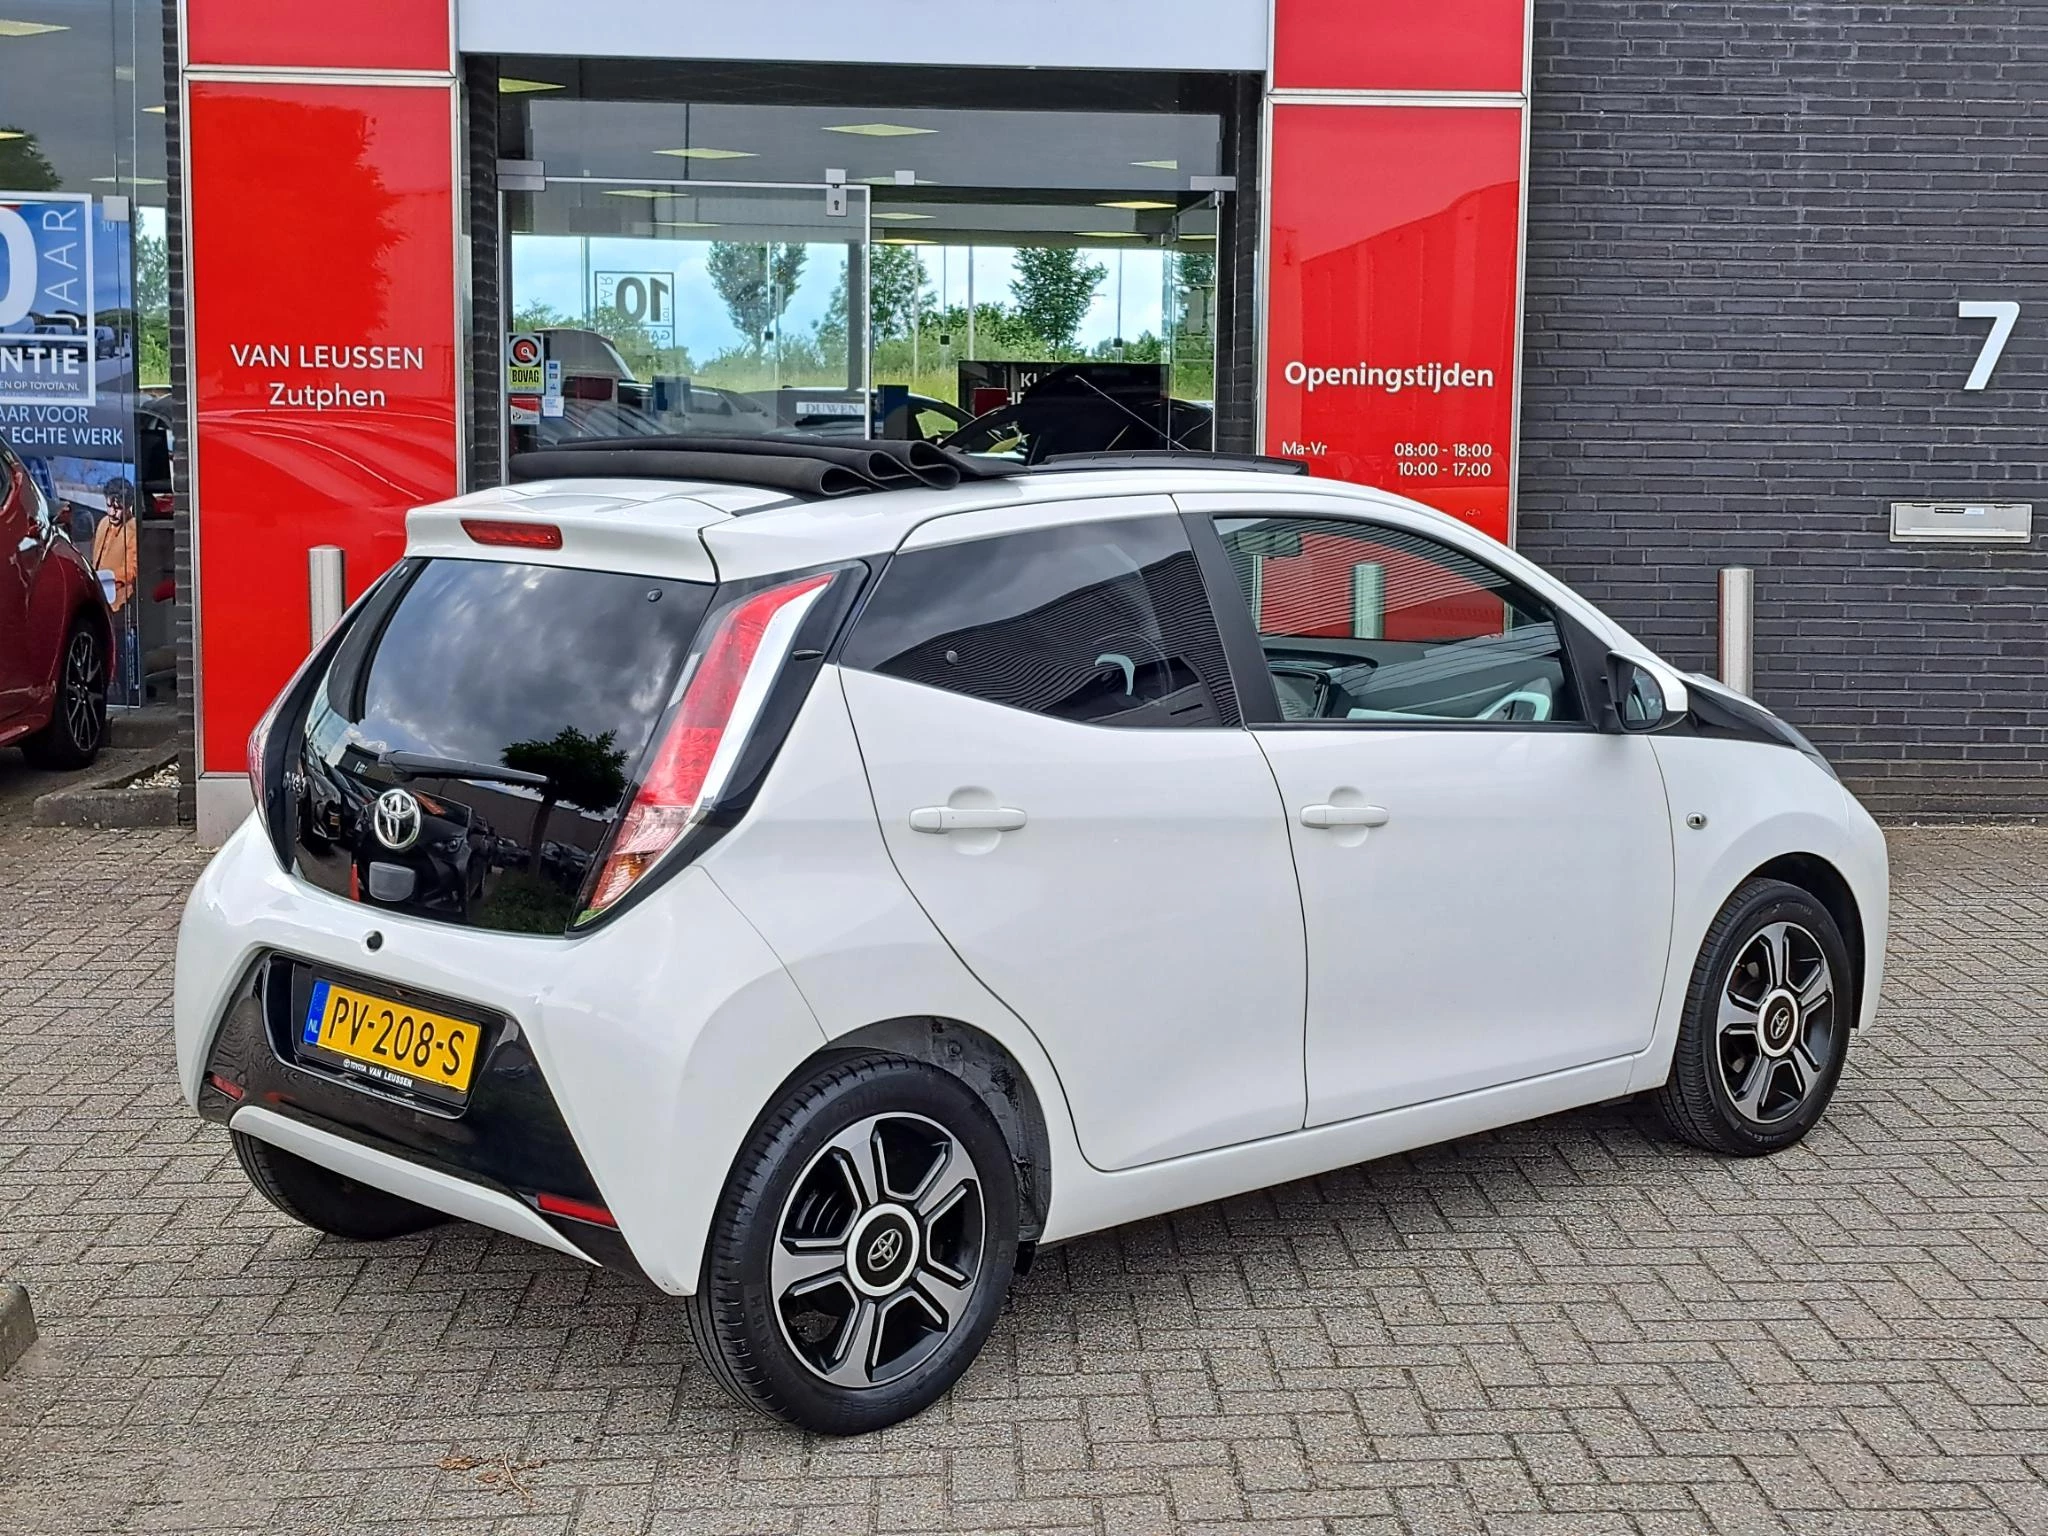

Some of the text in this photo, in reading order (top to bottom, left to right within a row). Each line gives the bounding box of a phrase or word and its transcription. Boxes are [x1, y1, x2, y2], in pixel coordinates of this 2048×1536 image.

[42, 208, 79, 330] JAAR
[230, 344, 423, 370] VAN LEUSSEN
[1958, 301, 2021, 390] 7
[14, 381, 28, 390] OP
[30, 381, 80, 392] TOYOTA.NL
[512, 369, 539, 383] BOVAG
[1284, 361, 1494, 393] Openingstijden
[269, 382, 386, 412] Zutphen
[34, 406, 89, 424] VOOR
[11, 426, 123, 446] ECHTE WERK
[1282, 441, 1328, 456] Ma-Vr
[1395, 442, 1438, 457] 08:00
[1453, 443, 1492, 458] 18:00
[1398, 462, 1438, 476] 10:00
[1453, 462, 1491, 476] 17:00
[307, 1018, 319, 1034] NL
[328, 996, 466, 1076] PV-208-S
[350, 1060, 413, 1088] TOYOTA VAN LEUSSEN
